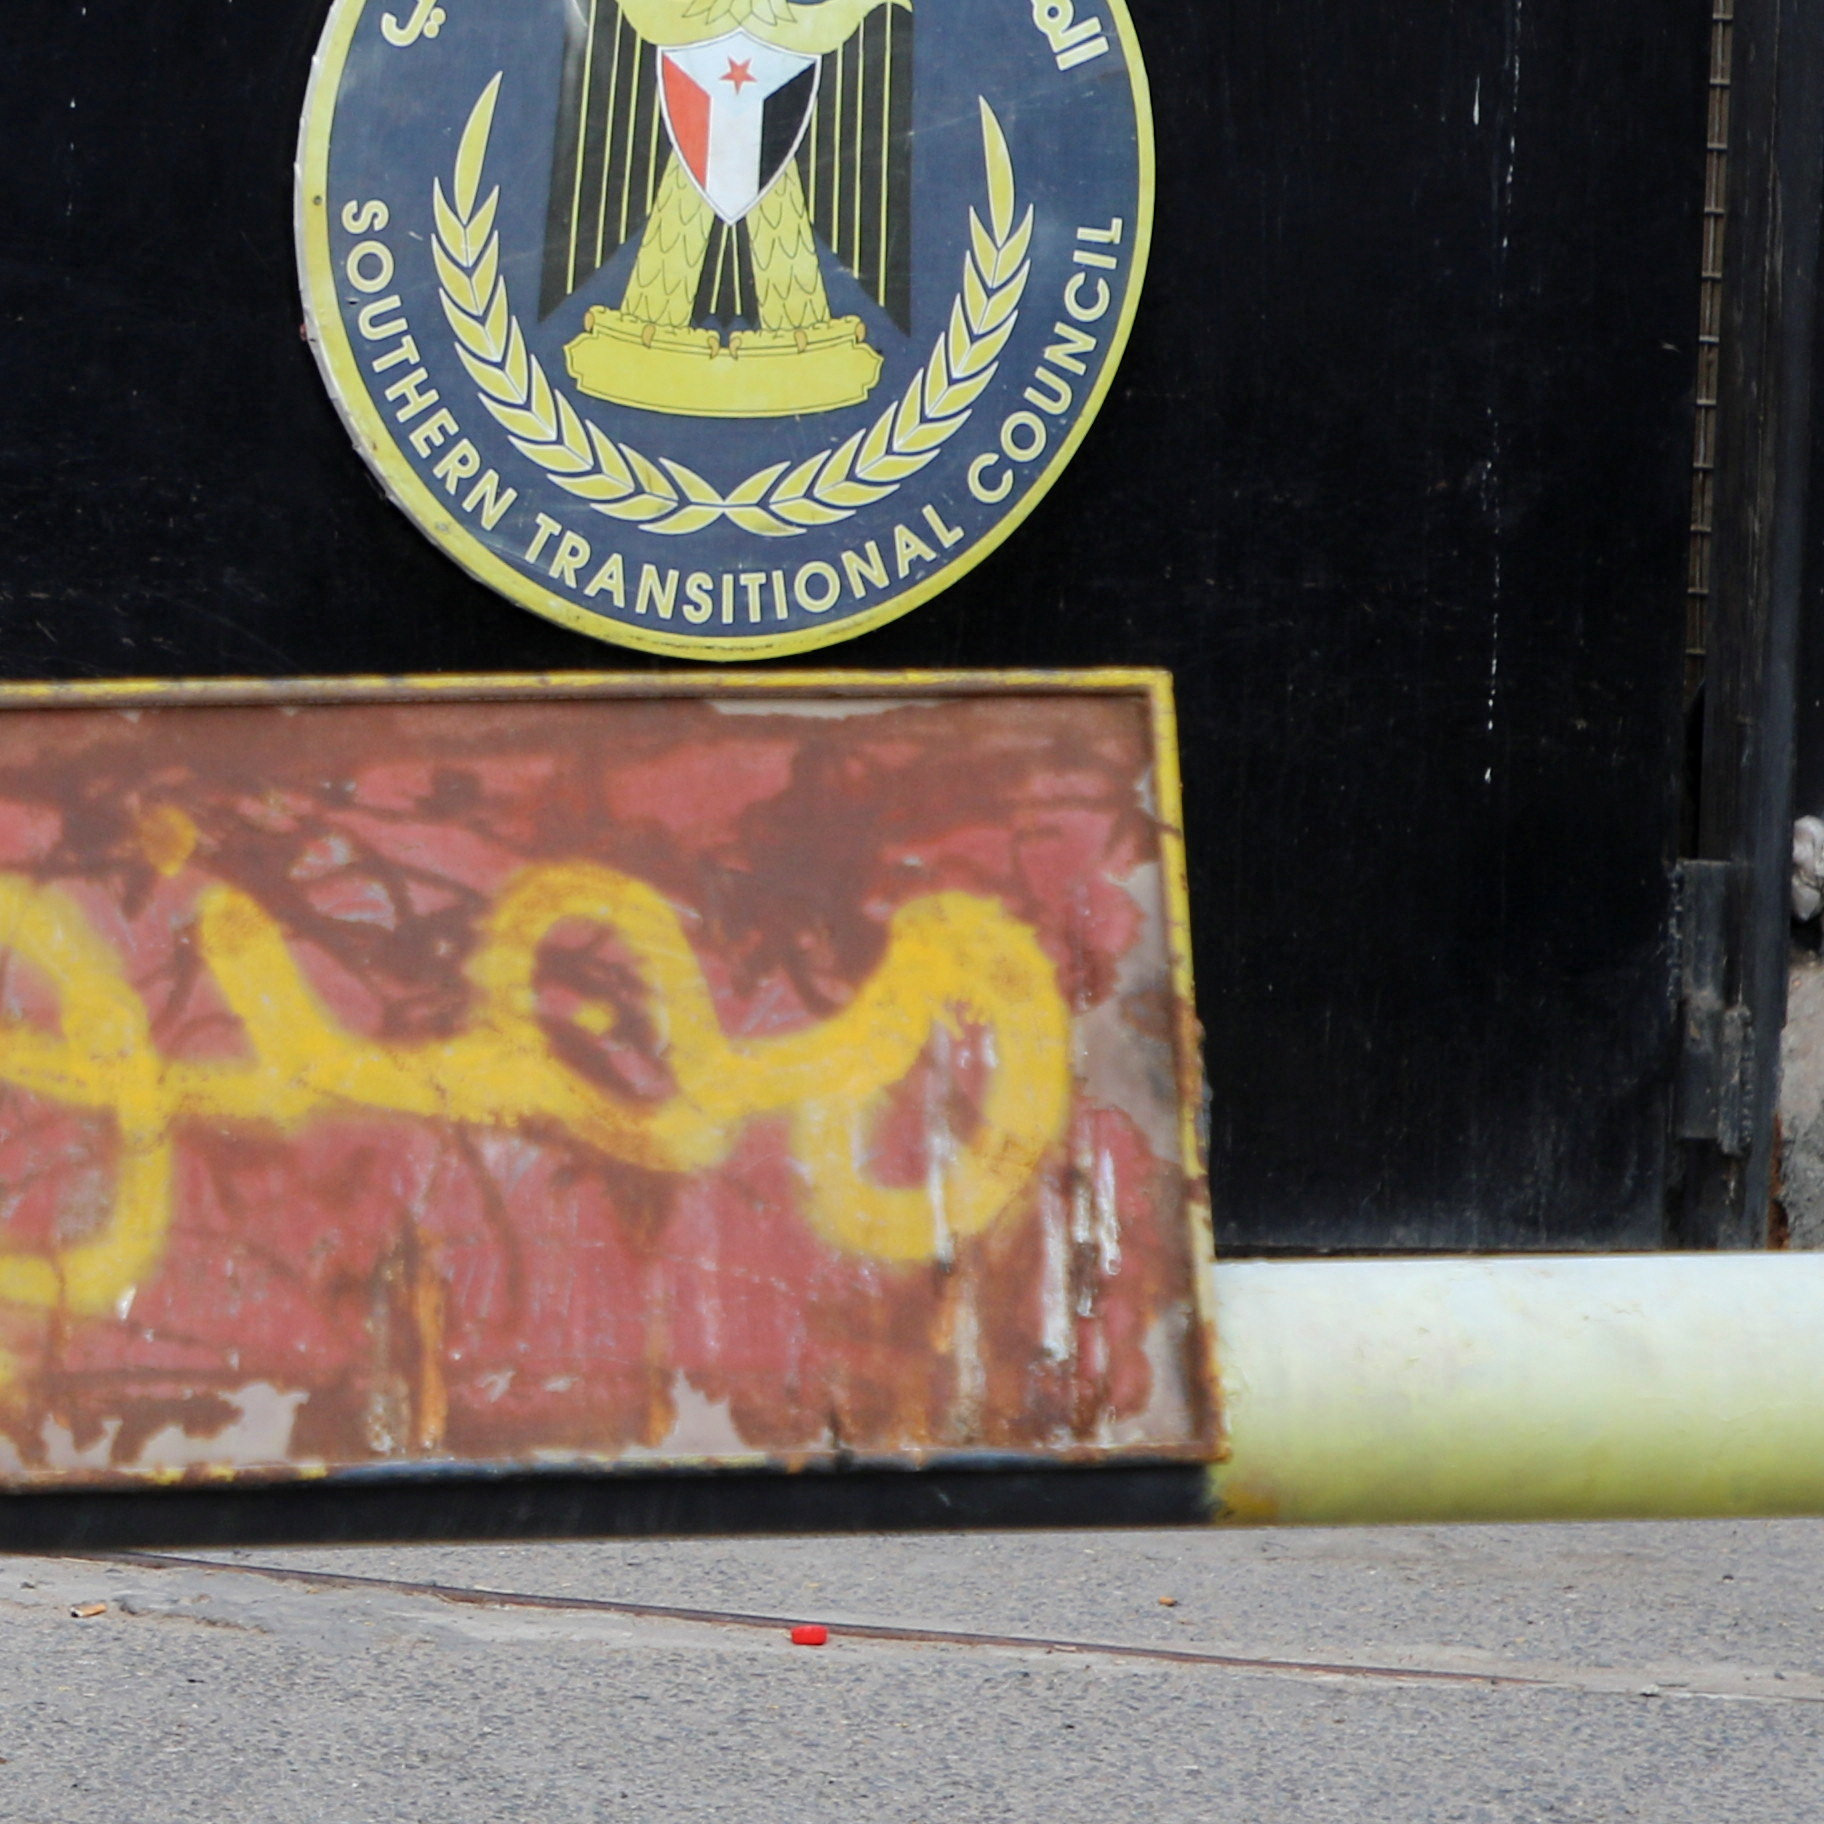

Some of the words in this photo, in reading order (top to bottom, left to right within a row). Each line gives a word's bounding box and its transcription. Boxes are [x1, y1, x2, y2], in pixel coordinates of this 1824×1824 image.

[341, 199, 517, 531] SOUTHERN
[524, 504, 965, 624] TRANSITIONAL
[968, 217, 1122, 504] COUNCIL
